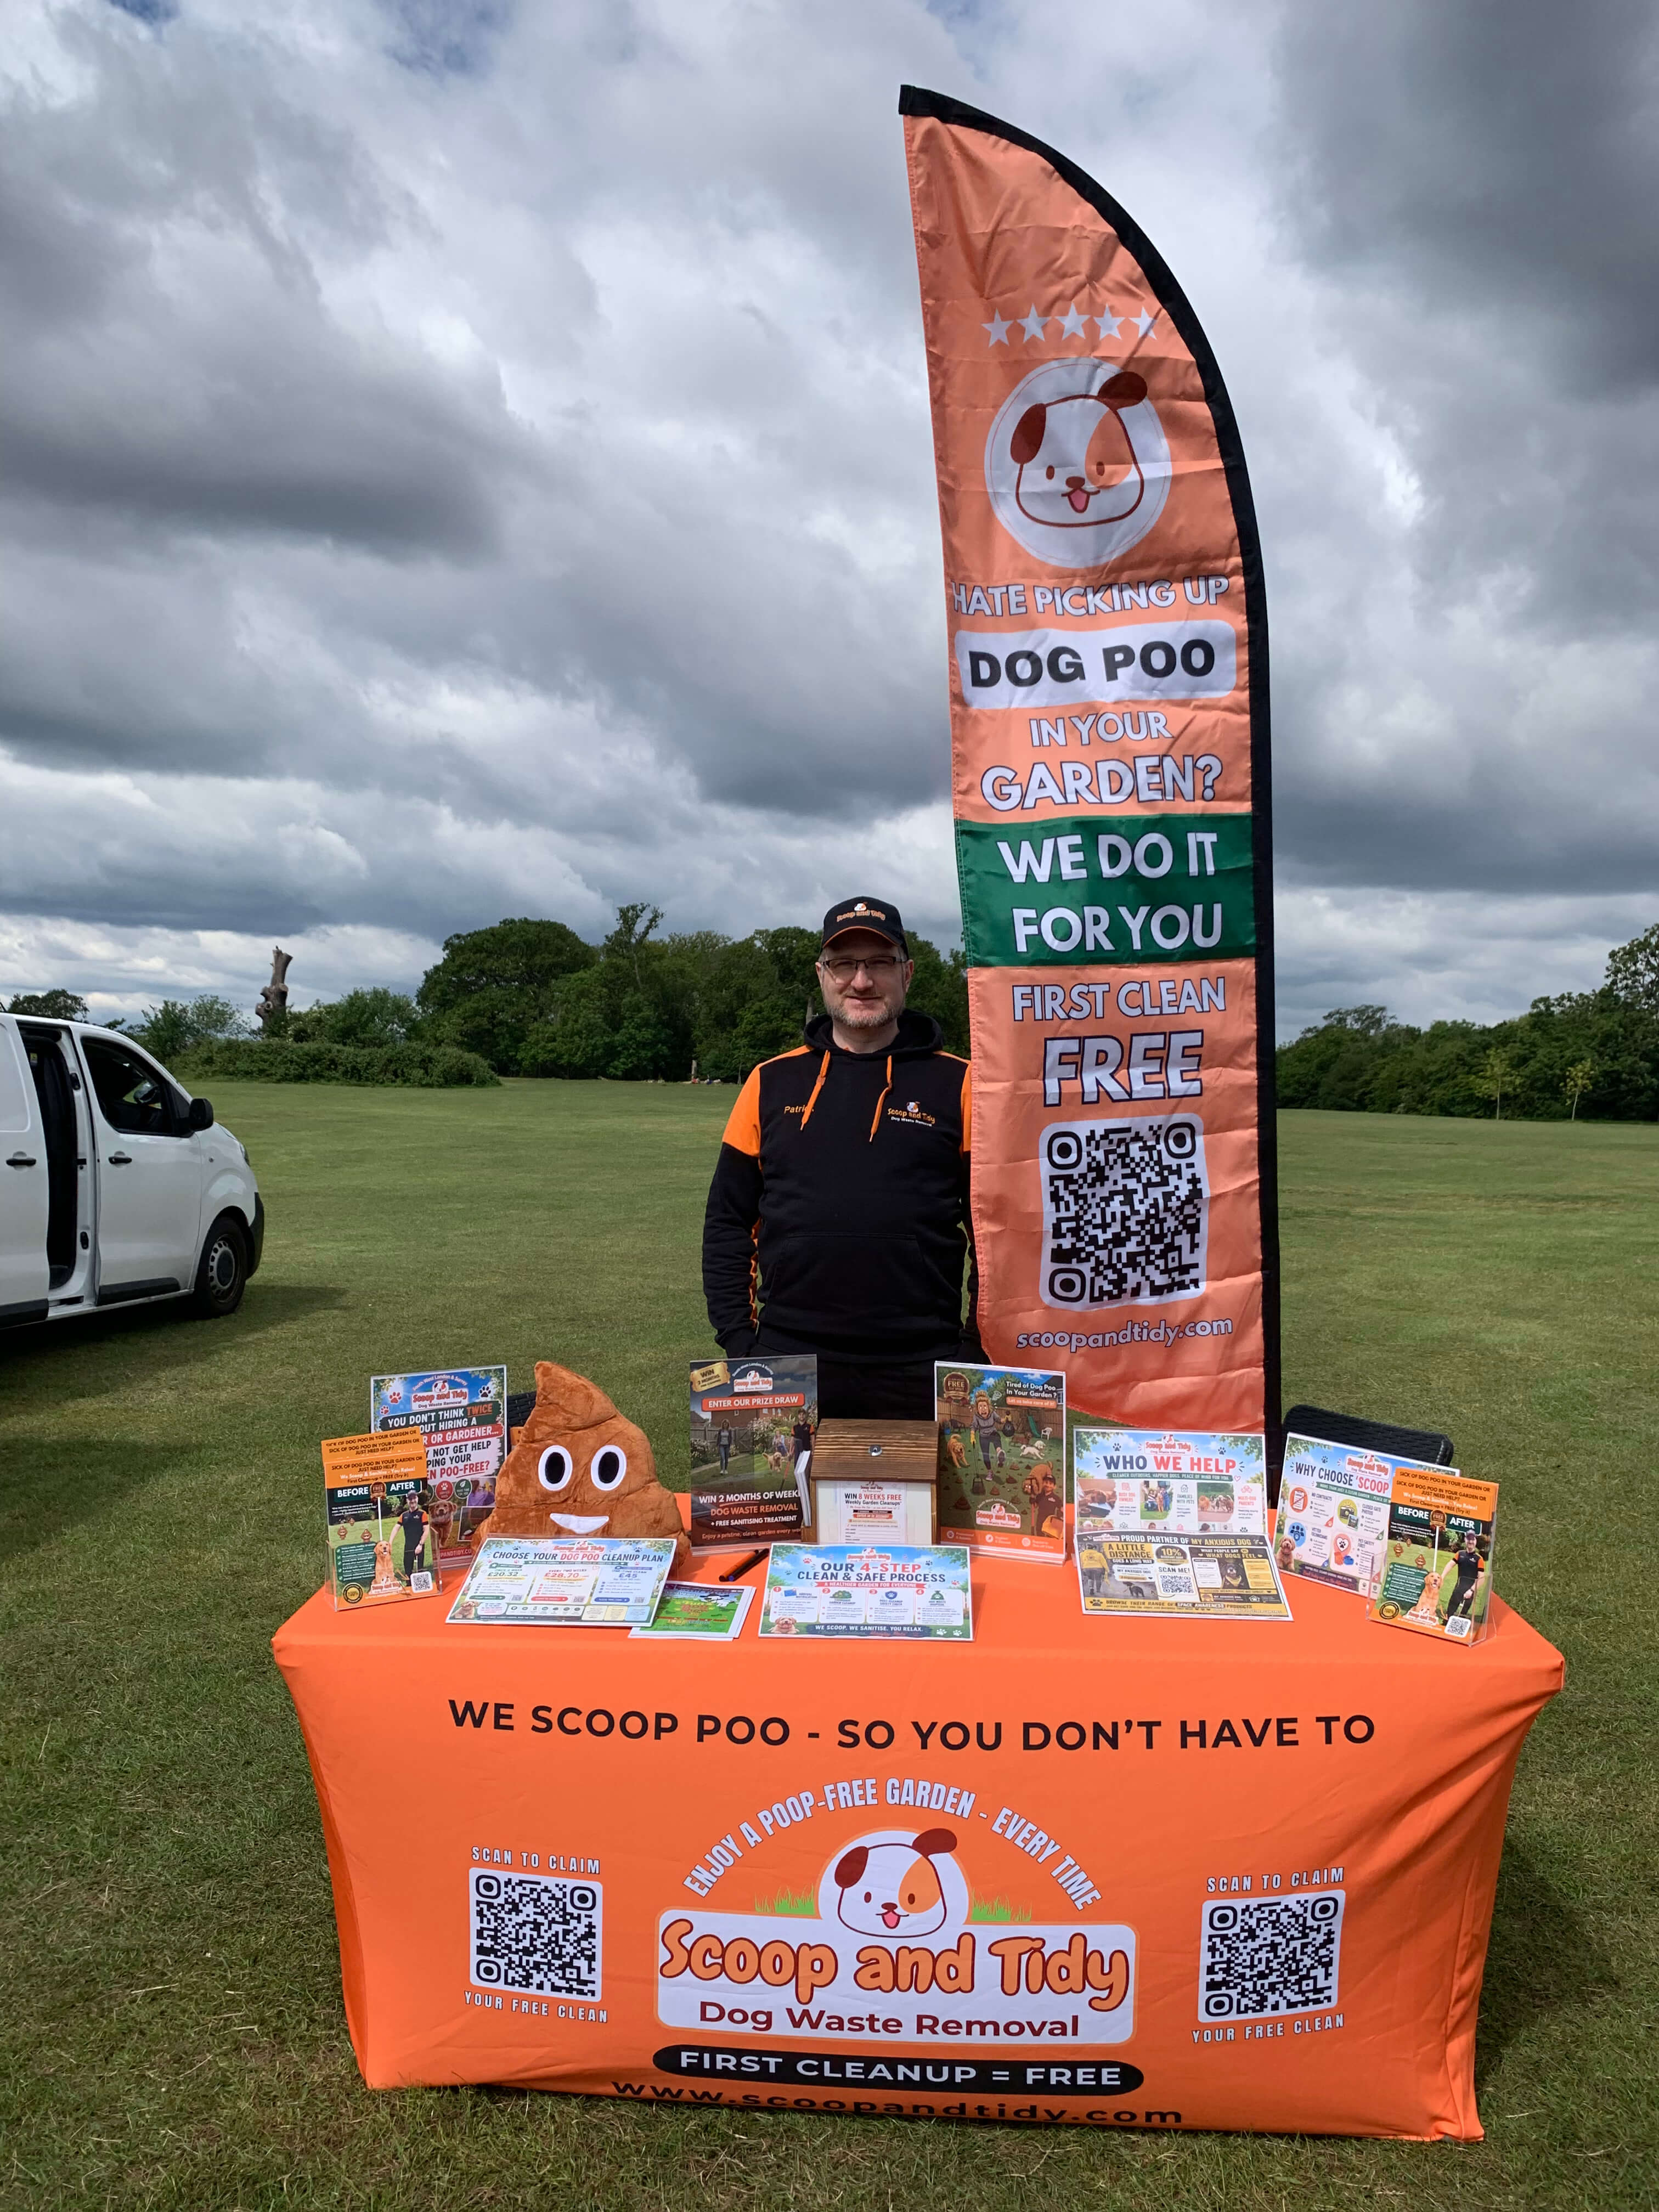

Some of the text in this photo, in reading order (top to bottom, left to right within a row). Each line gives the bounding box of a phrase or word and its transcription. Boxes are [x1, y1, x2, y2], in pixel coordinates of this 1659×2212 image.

[951, 574, 1229, 616] HATE PICKING UP
[969, 639, 1215, 687] DOG POO
[1029, 711, 1173, 747] IN YOUR
[980, 754, 1222, 811] GARDEN?
[996, 832, 1218, 883] WE DO IT
[1012, 903, 1222, 952] FOR YOU
[1013, 977, 1226, 1021] FIRST CLEAN
[1043, 1029, 1204, 1107] FREE
[888, 1108, 907, 1118] Scoop
[1017, 1318, 1233, 1353] scoopandtidy.com
[388, 1403, 493, 1427] YOU DON'T THINK TWICE
[708, 1400, 732, 1408] ENTER
[431, 1434, 443, 1444] OR
[445, 1426, 499, 1441] GARDENER...
[438, 1417, 477, 1431] HIRING A
[433, 1441, 492, 1457] NOT GET HELP
[450, 1453, 471, 1464] YOUR
[440, 1460, 490, 1479] POO-FREE?
[1103, 1455, 1237, 1473] WHO WE HELP
[1295, 1462, 1316, 1477] WHY
[1318, 1468, 1354, 1486] CHOOSE
[337, 1481, 415, 1498] BEFORE AFTER
[726, 1492, 761, 1502] MONTHS
[763, 1492, 775, 1500] OF
[730, 1517, 763, 1526] SANITISING
[731, 1506, 758, 1515] WASTE
[760, 1503, 798, 1513] REMOVAL
[1398, 1506, 1475, 1530] BEFORE AFTER
[1161, 1548, 1181, 1556] 10%
[798, 1571, 838, 1581] CLEAN
[856, 1573, 885, 1581] SAFE
[890, 1573, 945, 1582] PROCESS
[821, 1563, 921, 1573] OUR 4-STEP
[448, 1699, 1374, 1752] WE SCOOP POO SO YOU DON'T HAVE TO
[682, 1778, 1104, 1912] ENJOY A POOP-FREE GARDEN EVERY TIME
[471, 1846, 600, 1875] SCAN TO CLAIM
[1207, 1867, 1344, 1892] SCAN TO CLAIM
[659, 1918, 1130, 2012] Scoop and Tidy
[464, 1990, 608, 2023] YOUR FREE CLEAN
[699, 2001, 1079, 2037] Dog Waste Removal
[1192, 2014, 1344, 2043] YOUR FREE CLEAN
[680, 2051, 1121, 2085] FIRST CLEANUP FREE
[611, 2081, 1182, 2124] www.scoopandtidy.com
